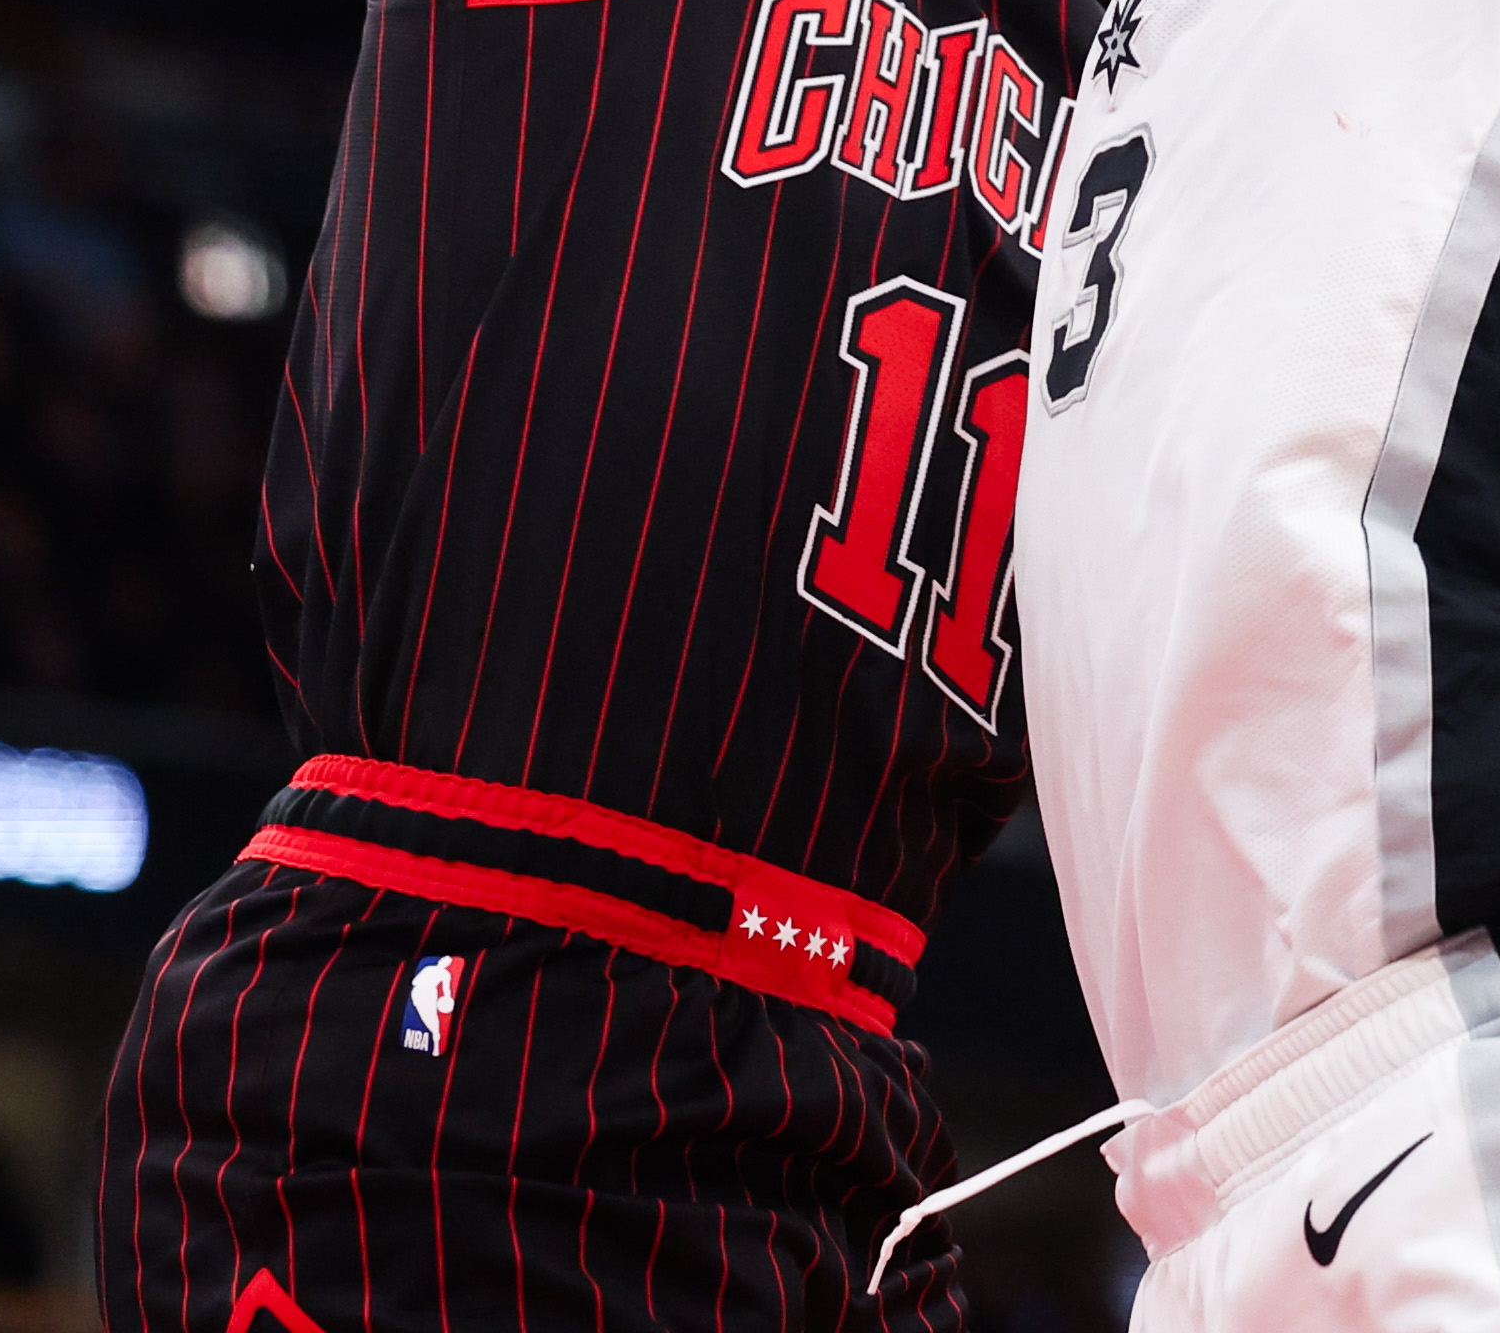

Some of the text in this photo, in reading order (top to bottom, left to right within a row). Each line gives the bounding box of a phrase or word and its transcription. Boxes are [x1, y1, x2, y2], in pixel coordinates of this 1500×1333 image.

[1040, 121, 1156, 419] 3
[797, 274, 1031, 736] 11
[403, 1028, 430, 1052] NBA
